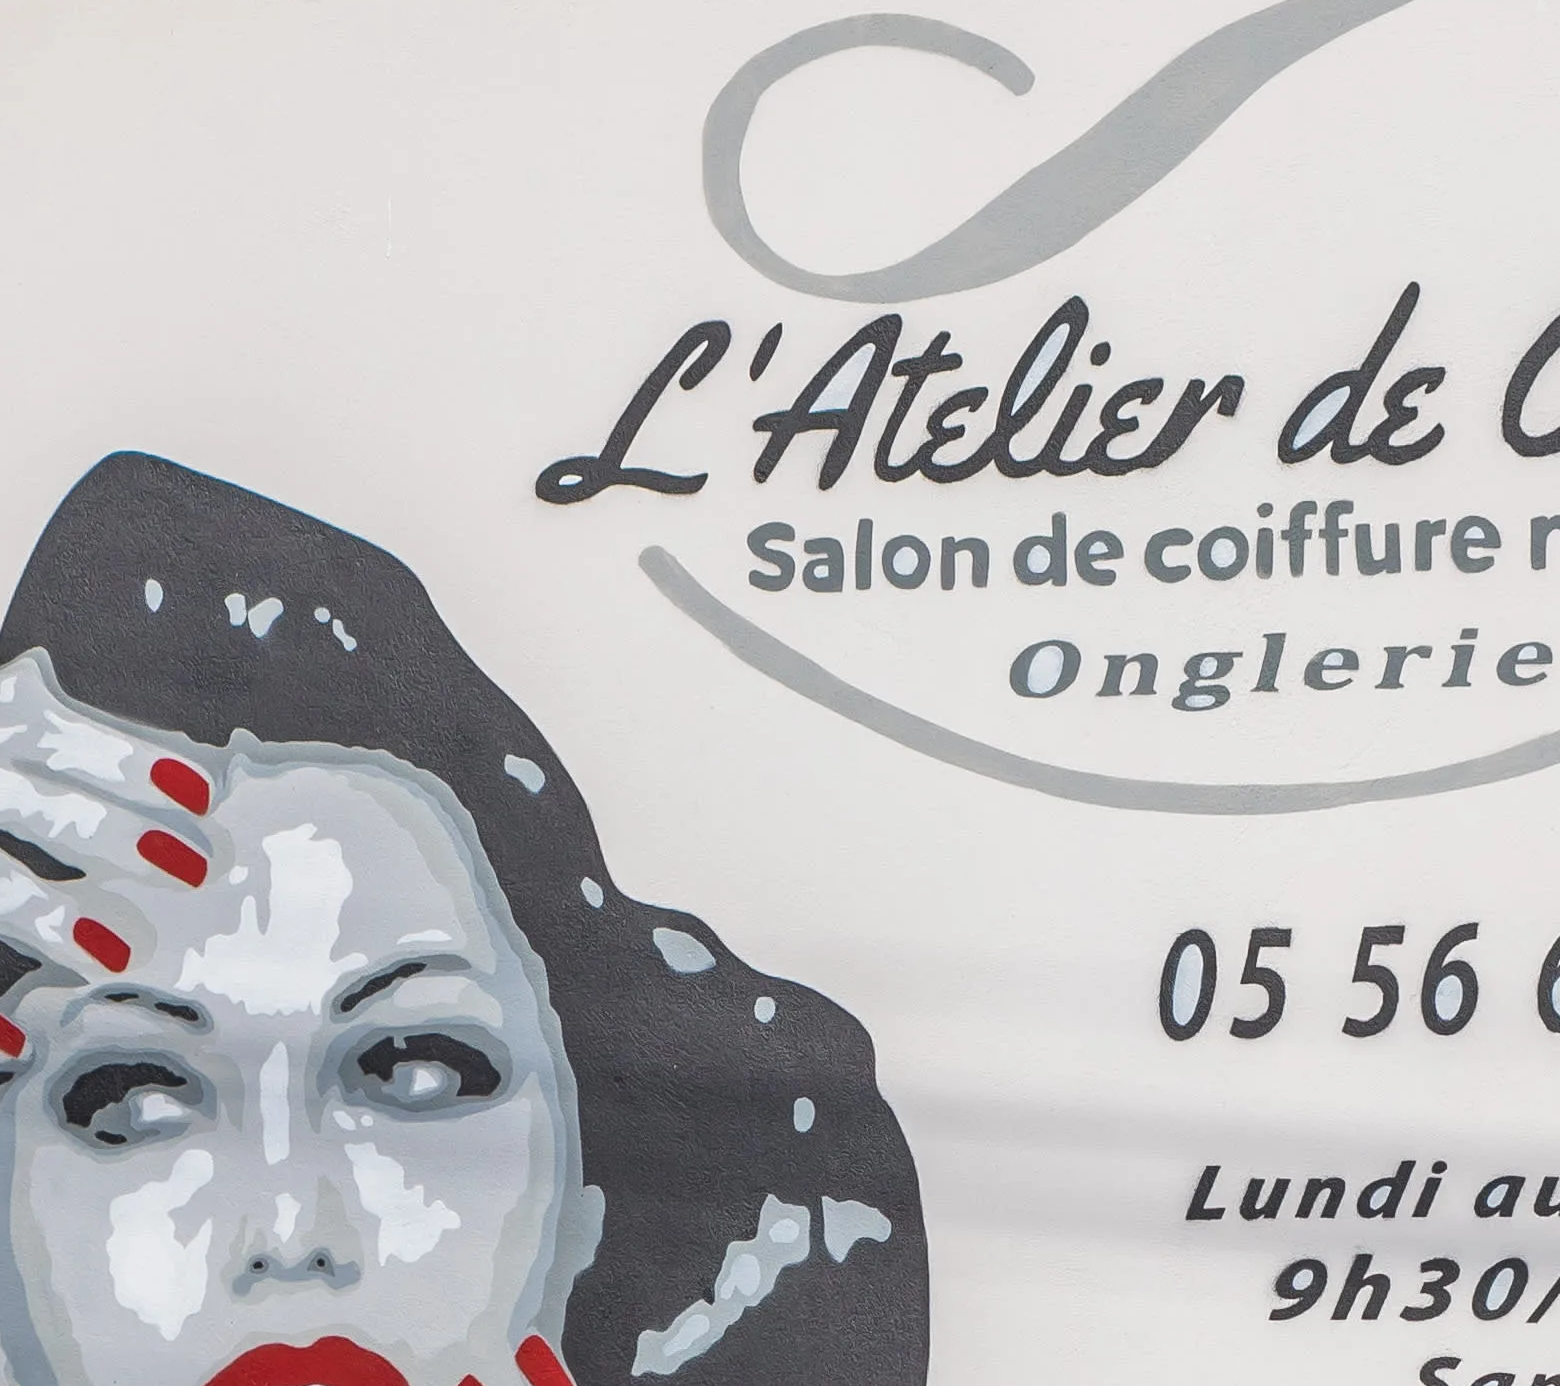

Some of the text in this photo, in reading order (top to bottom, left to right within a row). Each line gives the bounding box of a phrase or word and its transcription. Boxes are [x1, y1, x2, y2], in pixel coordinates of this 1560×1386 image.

[533, 293, 1246, 507] L'Atelier
[1276, 280, 1447, 467] de
[746, 517, 991, 594] Salon
[1012, 512, 1125, 588] de
[1143, 498, 1502, 584] coiffure
[1008, 627, 1554, 713] Onglerie
[1157, 927, 1293, 1043] 05
[1340, 921, 1480, 1039] 56
[1184, 1158, 1447, 1223] Lundi
